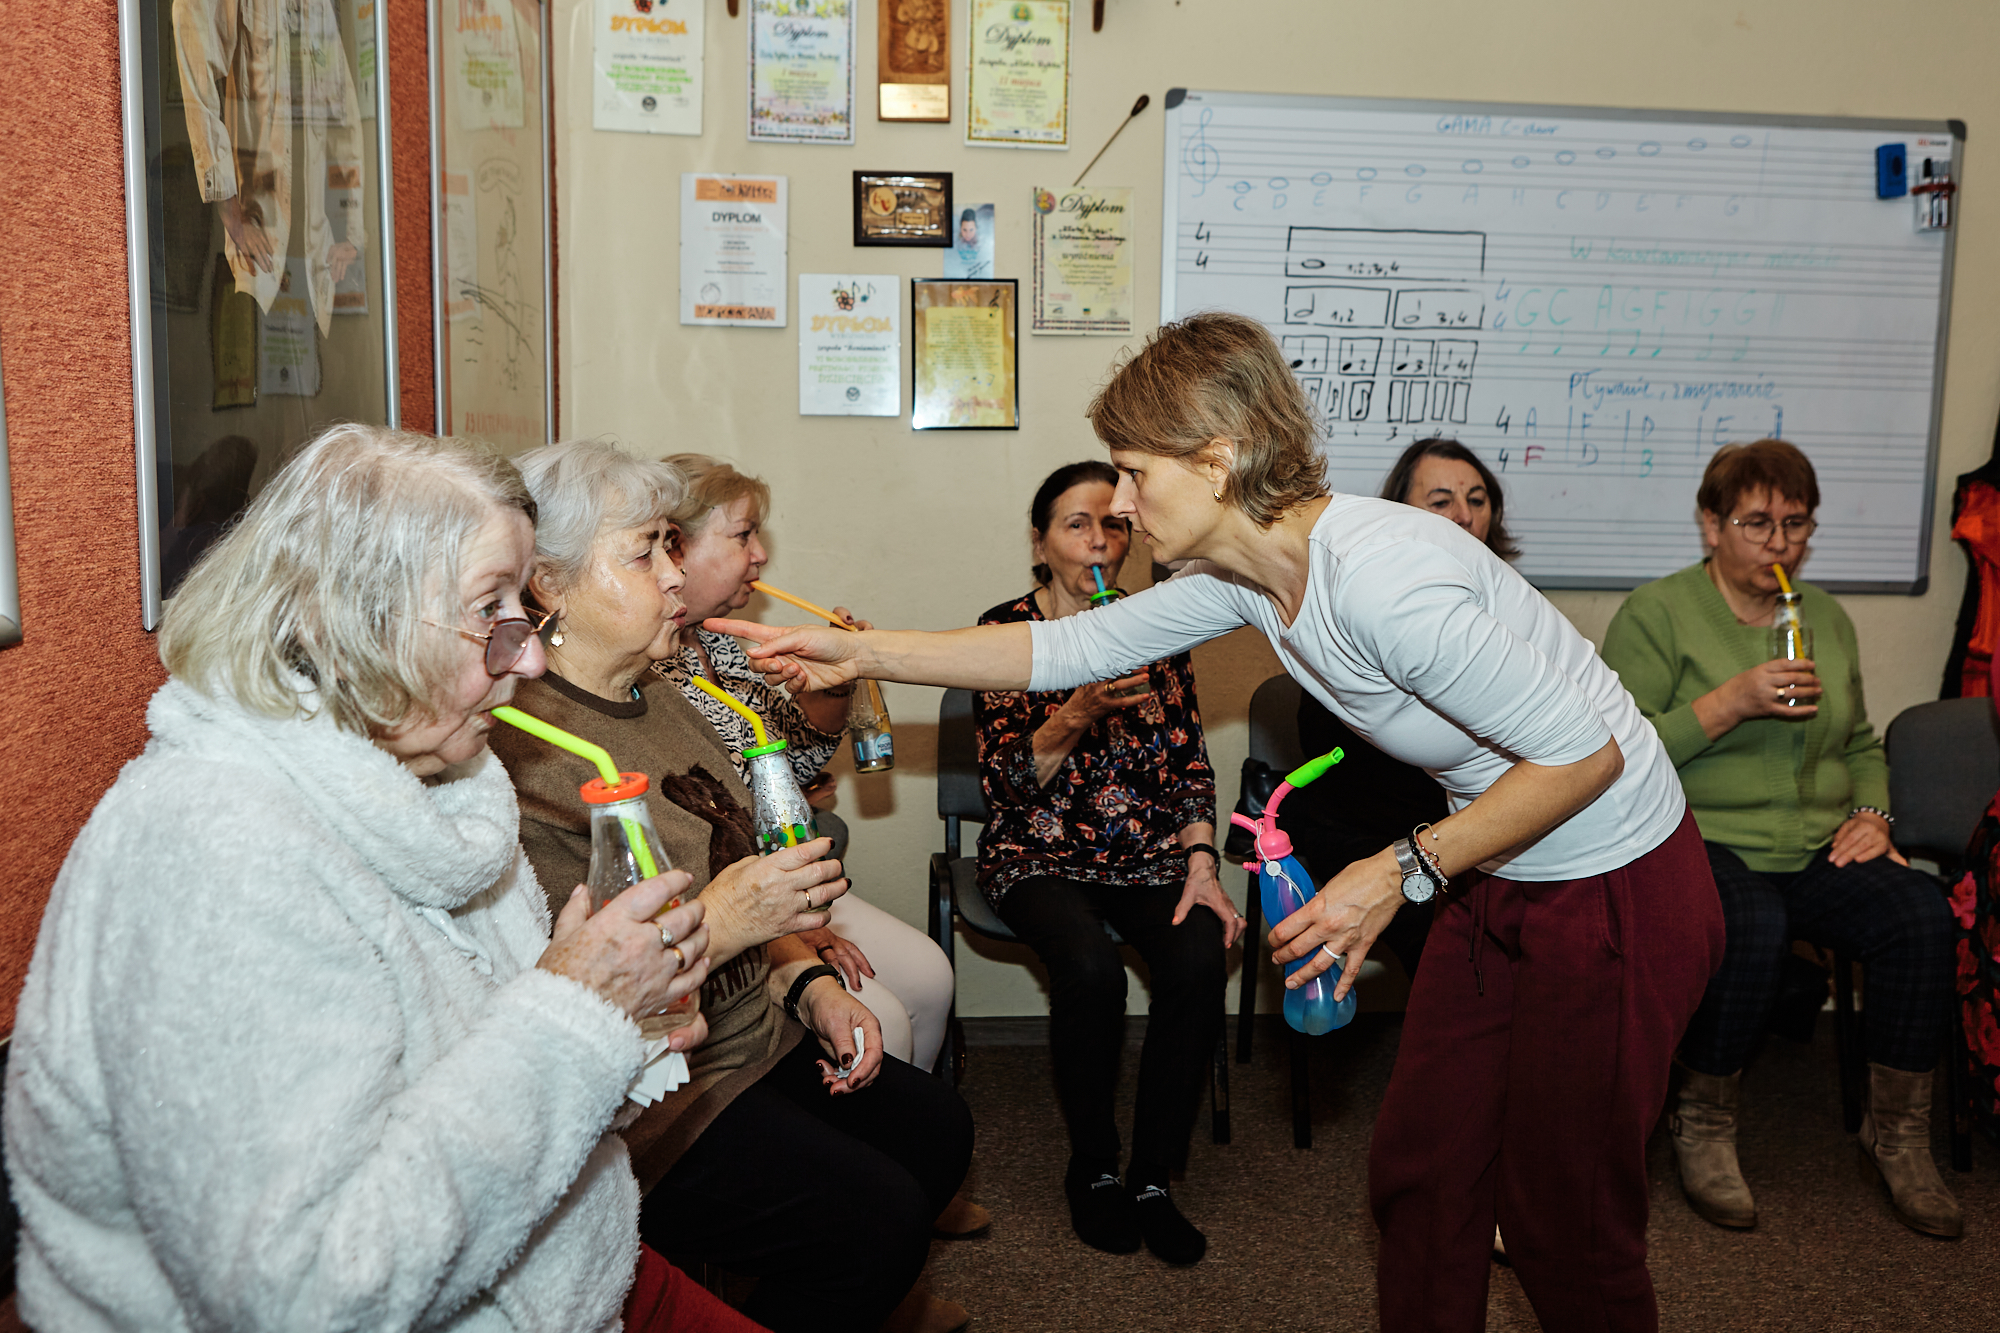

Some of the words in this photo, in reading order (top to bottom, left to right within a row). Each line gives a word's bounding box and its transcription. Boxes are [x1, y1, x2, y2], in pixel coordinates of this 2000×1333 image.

[773, 20, 829, 43] Dyplom
[983, 23, 1051, 51] Dyplom
[1436, 114, 1492, 135] GAMA
[1058, 193, 1125, 219] Dyplom
[1233, 196, 1247, 211] C
[1273, 193, 1288, 209] D
[1313, 190, 1327, 207] E
[1360, 185, 1373, 204] F
[1405, 184, 1423, 204] G
[1462, 183, 1479, 205] A
[1511, 187, 1525, 207] H
[712, 211, 762, 224] DYPLOM
[1195, 222, 1210, 243] 4
[1195, 251, 1209, 270] 4
[1494, 277, 1511, 303] 4
[1492, 310, 1507, 331] 4
[1359, 359, 1367, 372] 2
[1413, 360, 1423, 373] 3
[1457, 360, 1468, 373] 4
[1386, 426, 1398, 441] 3
[1495, 405, 1511, 434] 4
[1525, 407, 1537, 438] A
[1582, 412, 1594, 440] F
[1712, 415, 1735, 446] E
[1498, 448, 1509, 473] 4
[1524, 445, 1545, 467] F
[1577, 443, 1599, 468] D
[1090, 1179, 1115, 1190] PUMA
[1136, 1191, 1161, 1202] PUMA
